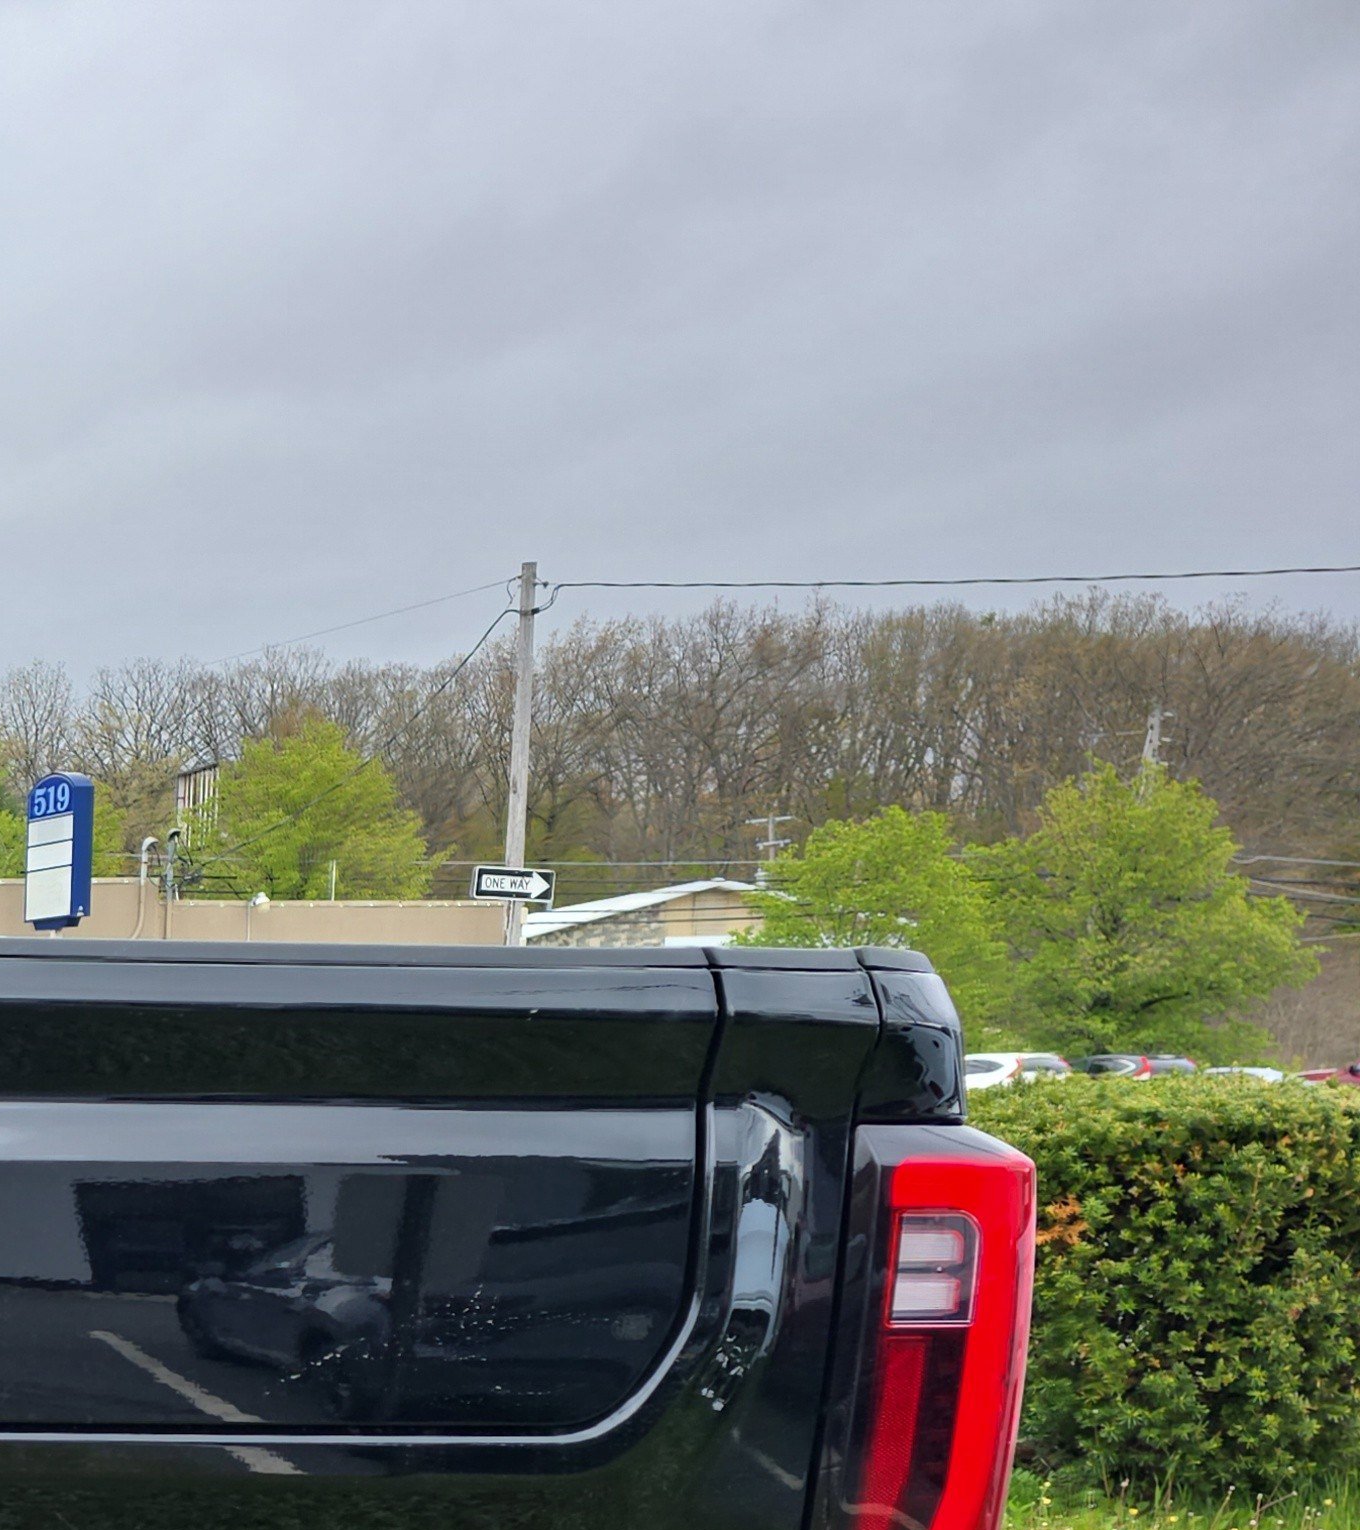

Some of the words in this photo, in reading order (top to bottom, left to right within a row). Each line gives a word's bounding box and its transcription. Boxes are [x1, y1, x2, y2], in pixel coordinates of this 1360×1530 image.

[33, 782, 71, 816] 519
[485, 877, 506, 889] ONE
[509, 878, 531, 890] WAY
